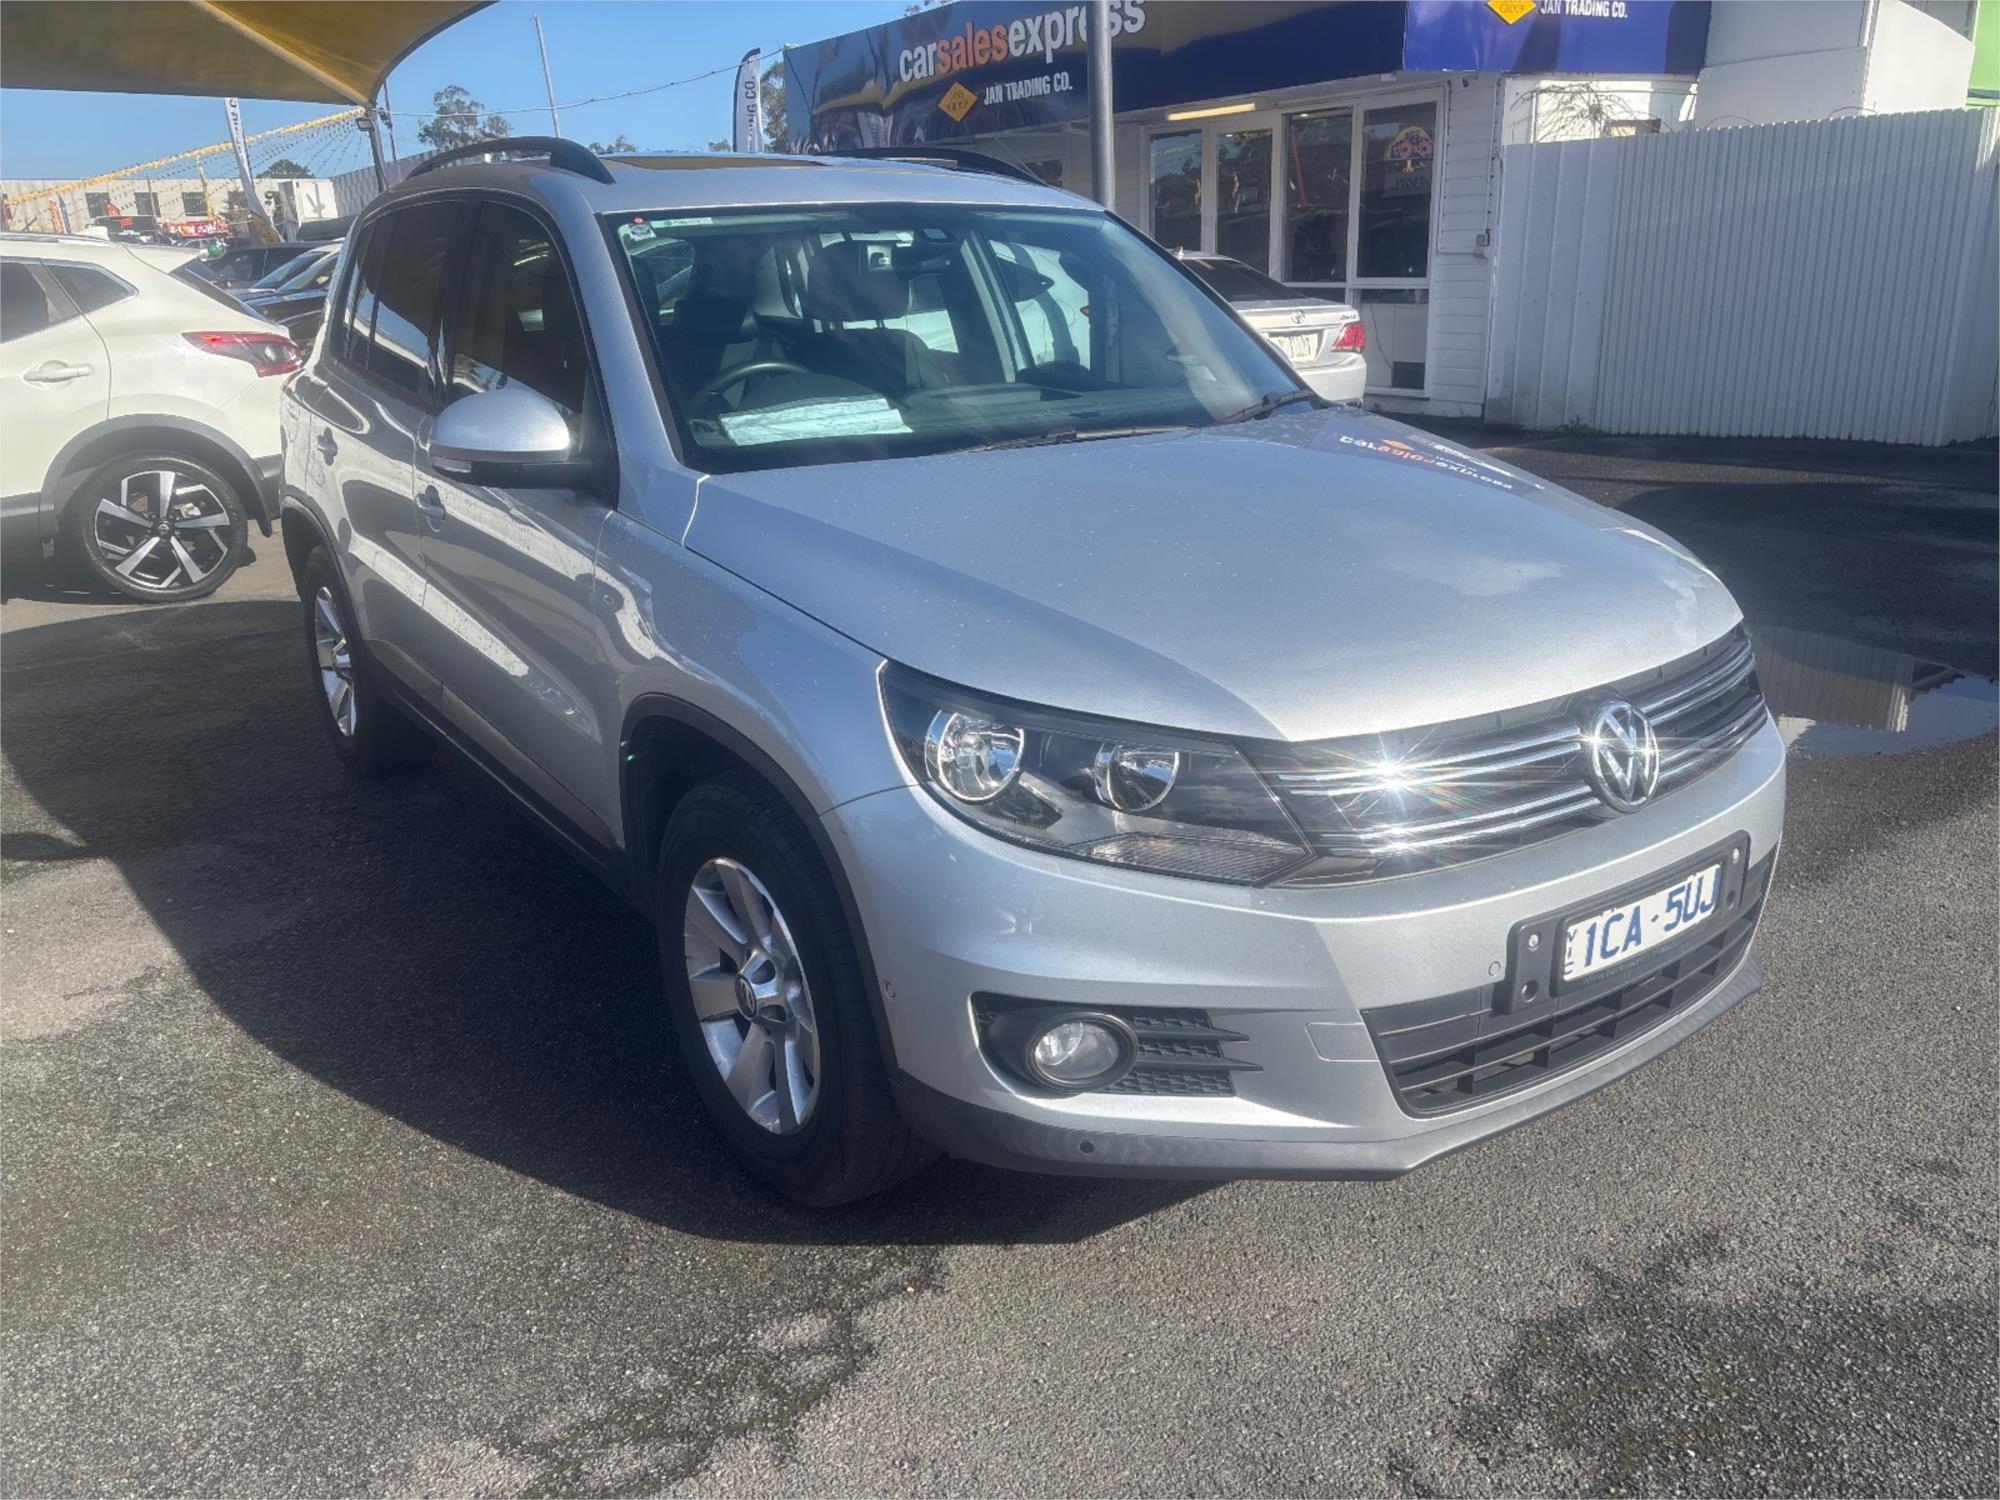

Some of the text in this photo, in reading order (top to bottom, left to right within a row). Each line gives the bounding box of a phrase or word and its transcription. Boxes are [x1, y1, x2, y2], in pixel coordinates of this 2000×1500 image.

[1541, 0, 1560, 14] JAN
[1565, 0, 1609, 17] TRADING
[1611, 1, 1628, 18] CO.
[983, 84, 1003, 106] JAN
[1006, 76, 1051, 101] TRADING
[1053, 71, 1073, 92] CO.
